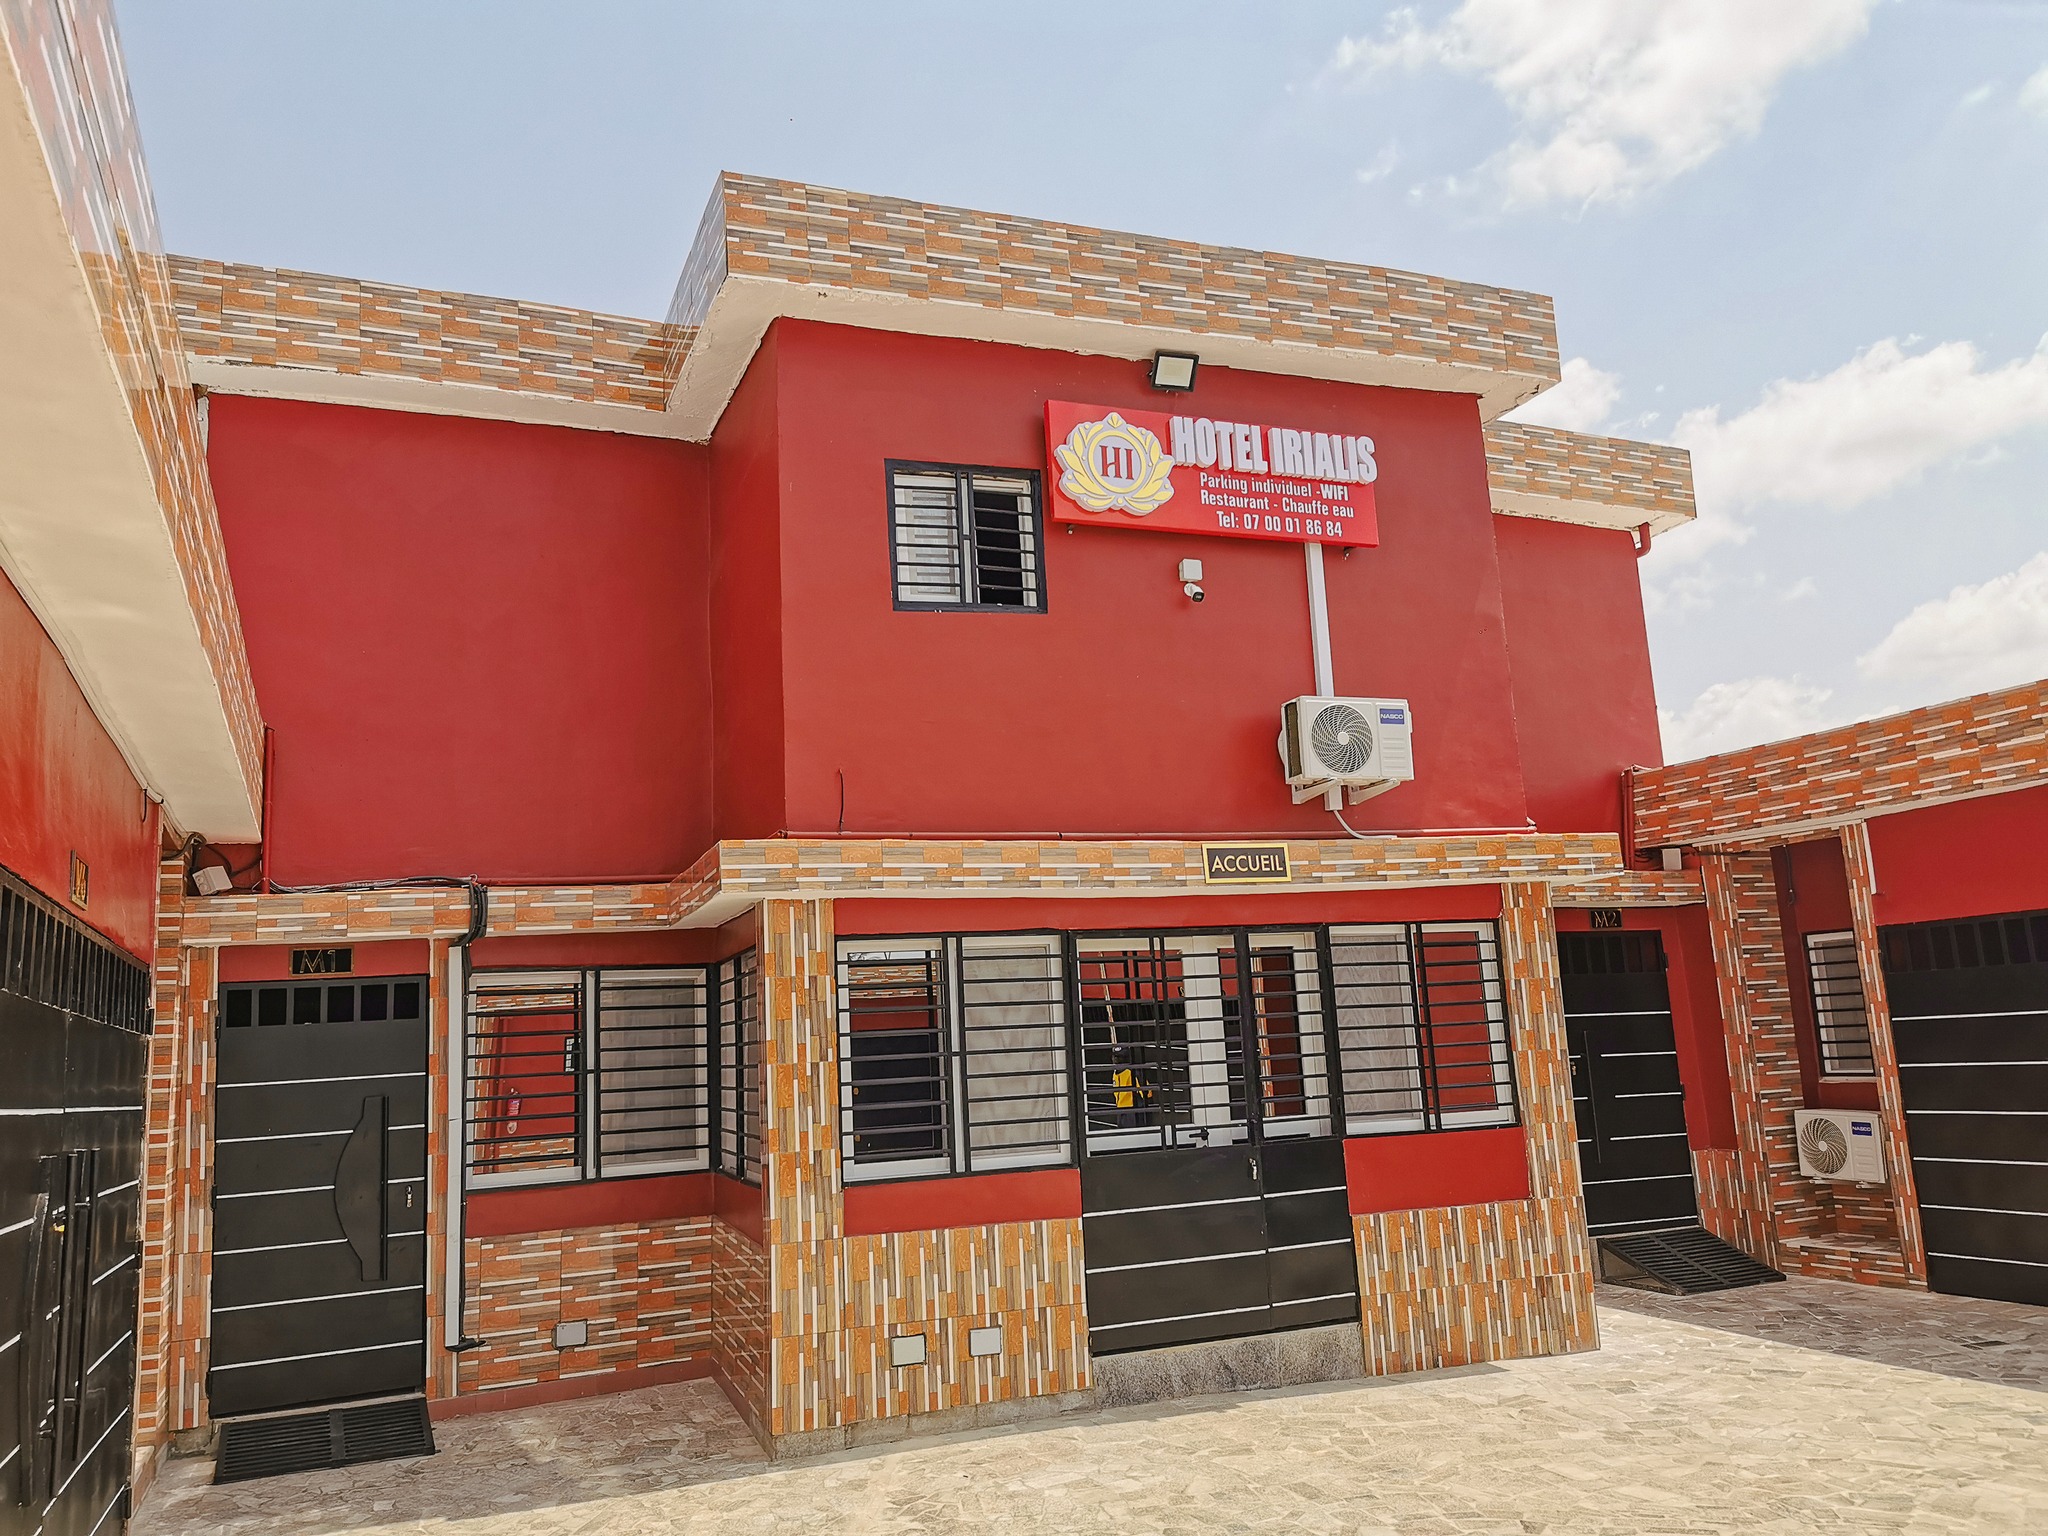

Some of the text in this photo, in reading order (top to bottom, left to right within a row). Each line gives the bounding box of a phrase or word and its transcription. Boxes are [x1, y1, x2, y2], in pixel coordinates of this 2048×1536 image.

[1169, 416, 1378, 484] HOTEL IRIALIS
[1200, 472, 1248, 494] Parking
[1251, 478, 1312, 497] individuel
[1200, 489, 1270, 510] Restaurant
[1282, 497, 1329, 516] Chauffe
[1332, 505, 1354, 518] eau
[1216, 511, 1343, 538] Tel: 07 00 01 86 84
[1211, 854, 1284, 873] ACCUEIL
[1594, 911, 1618, 928] M2
[299, 949, 336, 974] M1
